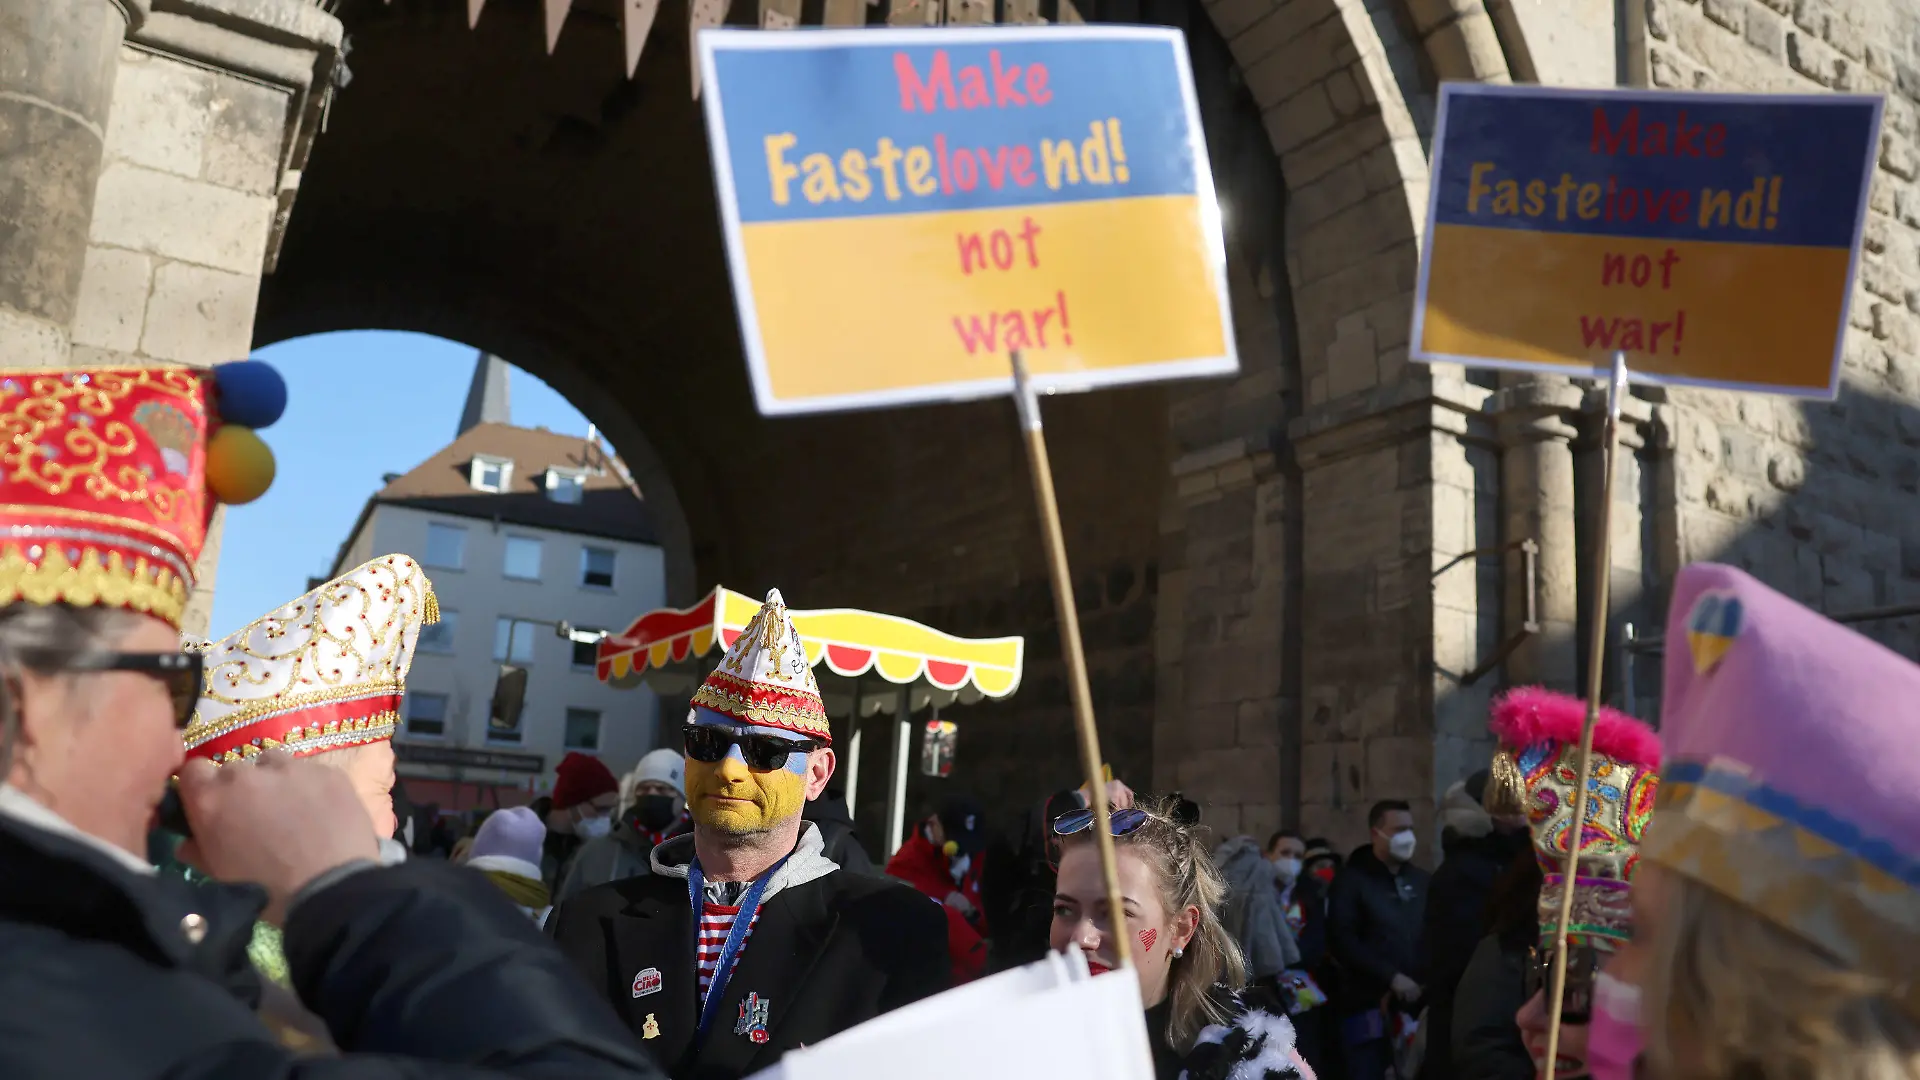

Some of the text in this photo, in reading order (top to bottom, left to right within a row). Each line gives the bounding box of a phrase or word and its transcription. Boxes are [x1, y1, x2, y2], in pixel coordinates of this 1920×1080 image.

[893, 49, 1053, 114] Make
[763, 117, 1130, 206] Fastelovend!
[1589, 106, 1728, 158] Make
[1466, 161, 1782, 231] Fastelovend!
[957, 216, 1042, 275] not
[1601, 247, 1681, 290] not
[952, 290, 1074, 355] war!
[1580, 310, 1687, 357] war!
